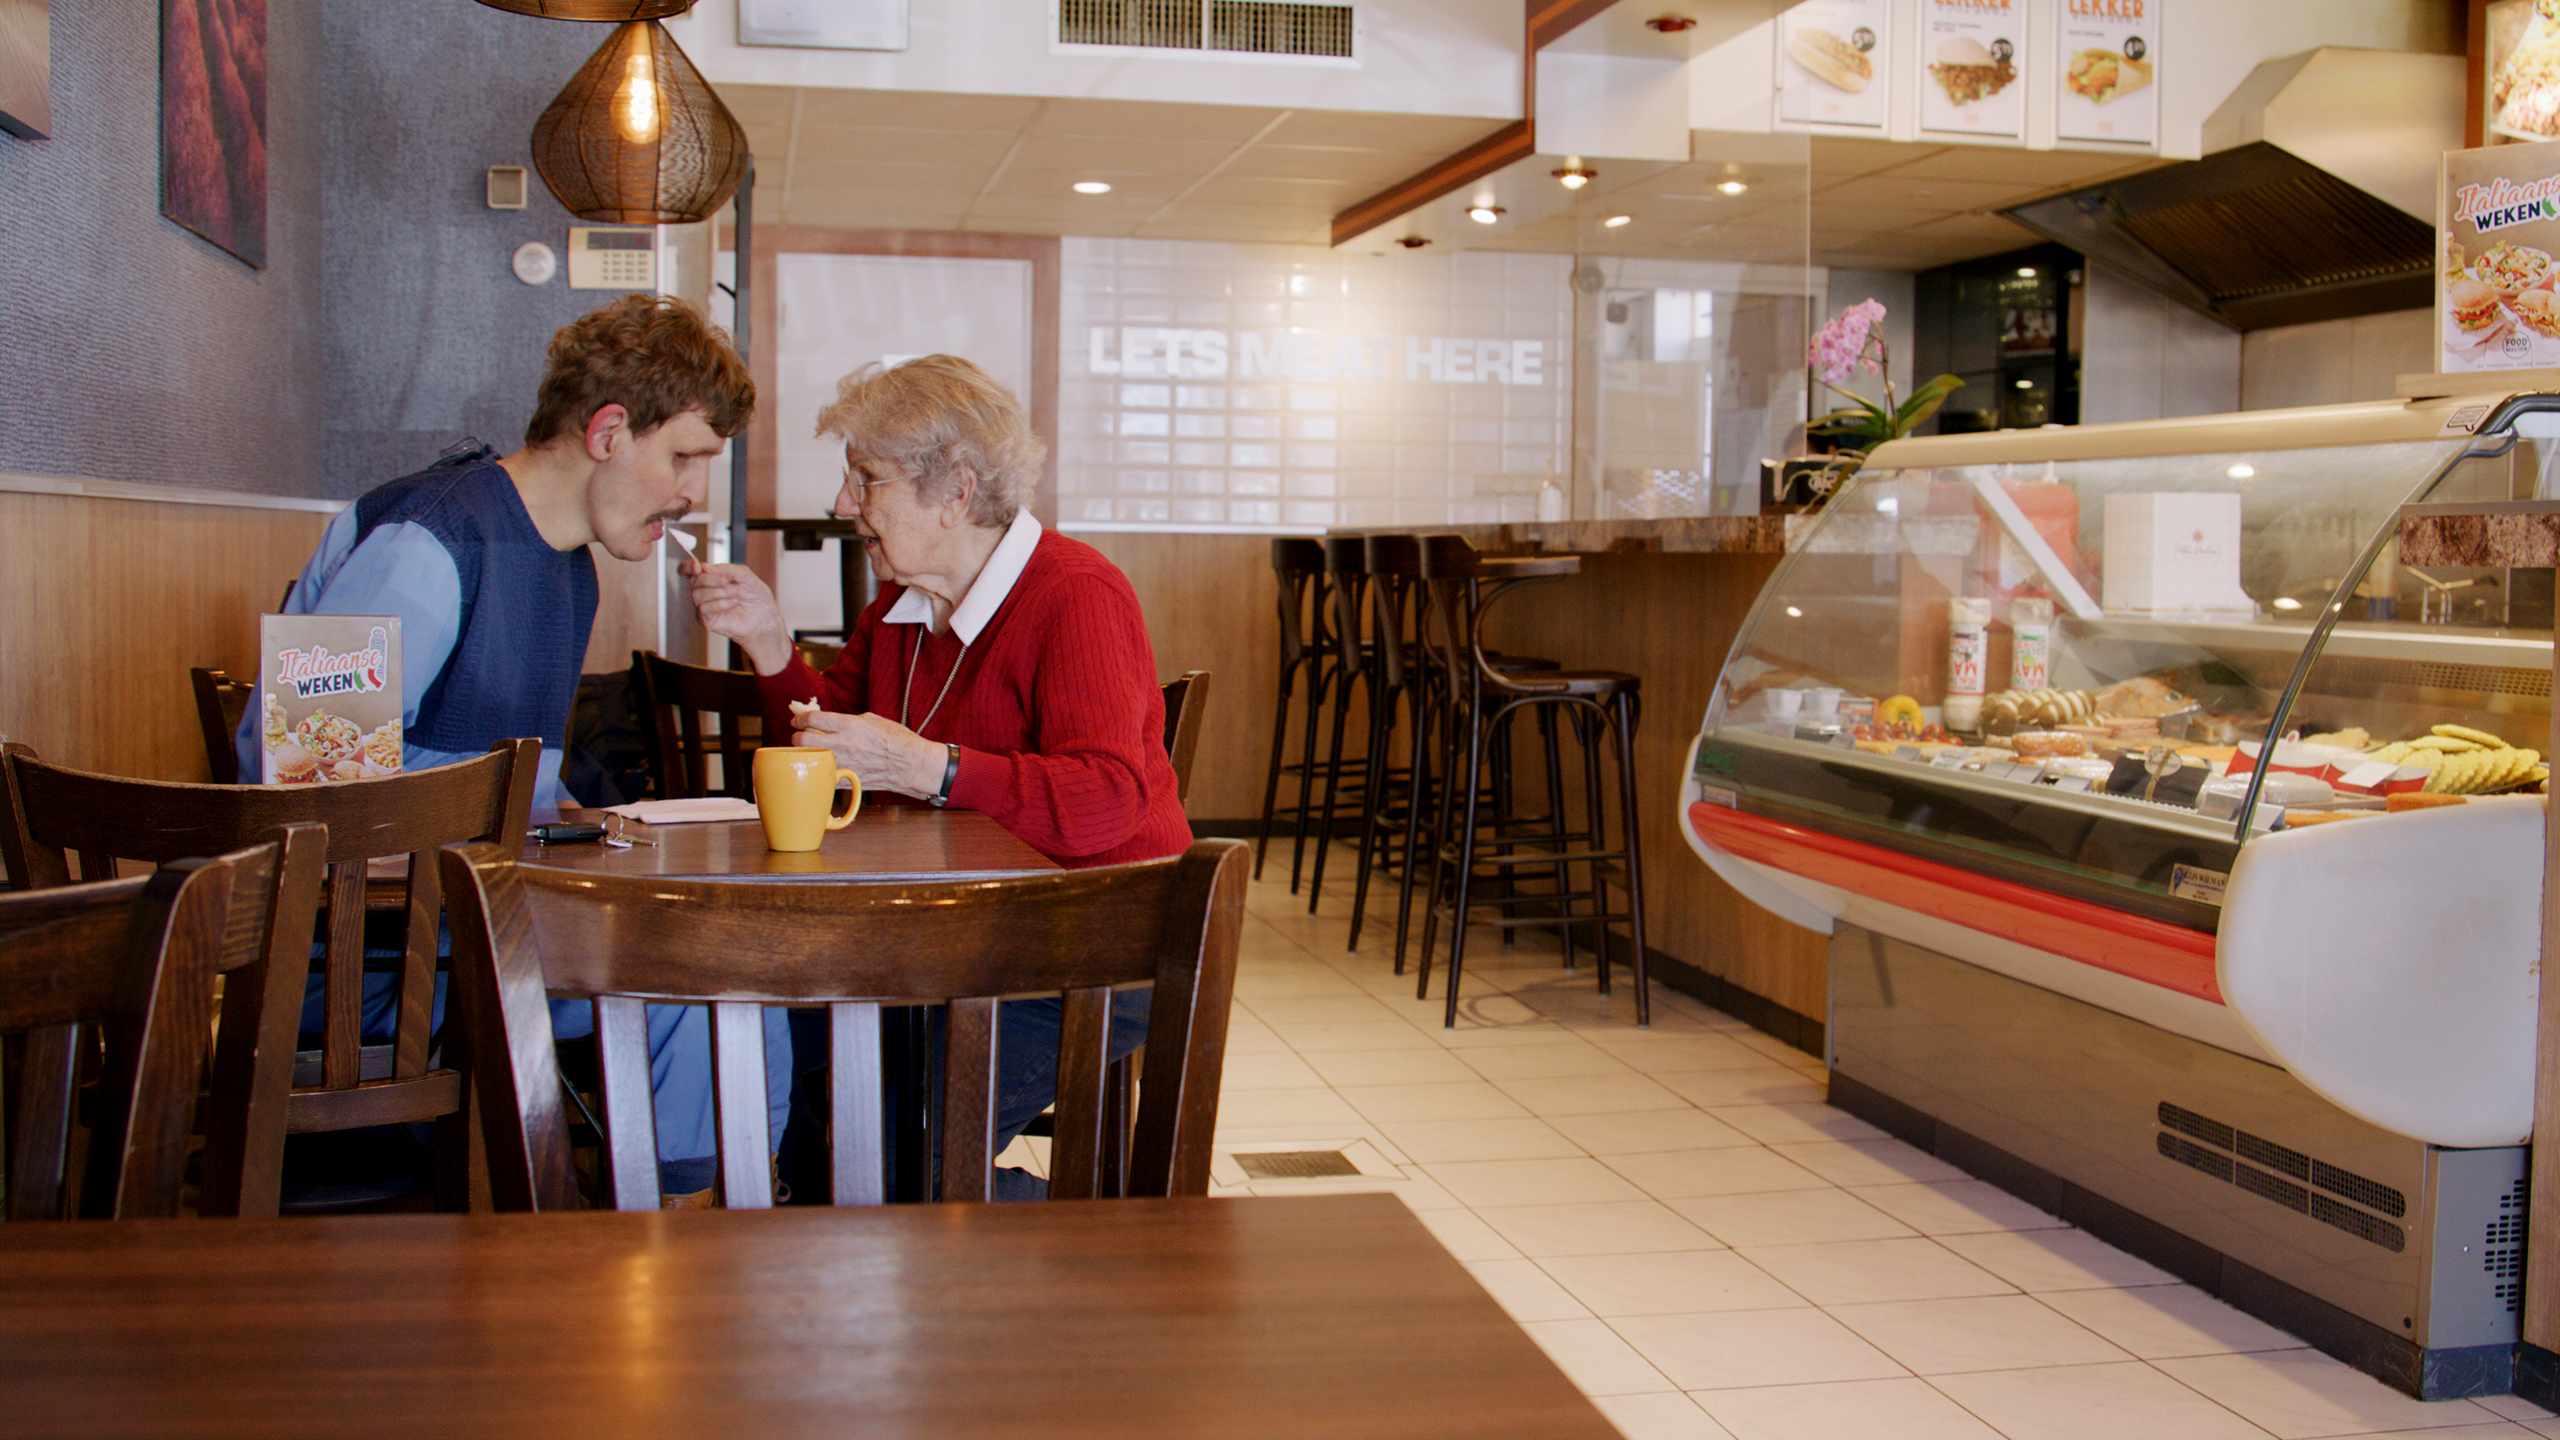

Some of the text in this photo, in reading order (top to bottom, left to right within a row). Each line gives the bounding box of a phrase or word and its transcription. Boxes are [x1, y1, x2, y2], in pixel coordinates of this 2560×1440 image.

[2069, 0, 2144, 18] LEKKER
[2476, 201, 2540, 230] WEKEN
[1089, 326, 1543, 385] LETS MEAT HERE
[2505, 338, 2528, 347] FOOD
[280, 647, 381, 681] Italiaanse
[297, 672, 353, 696] WEKEN
